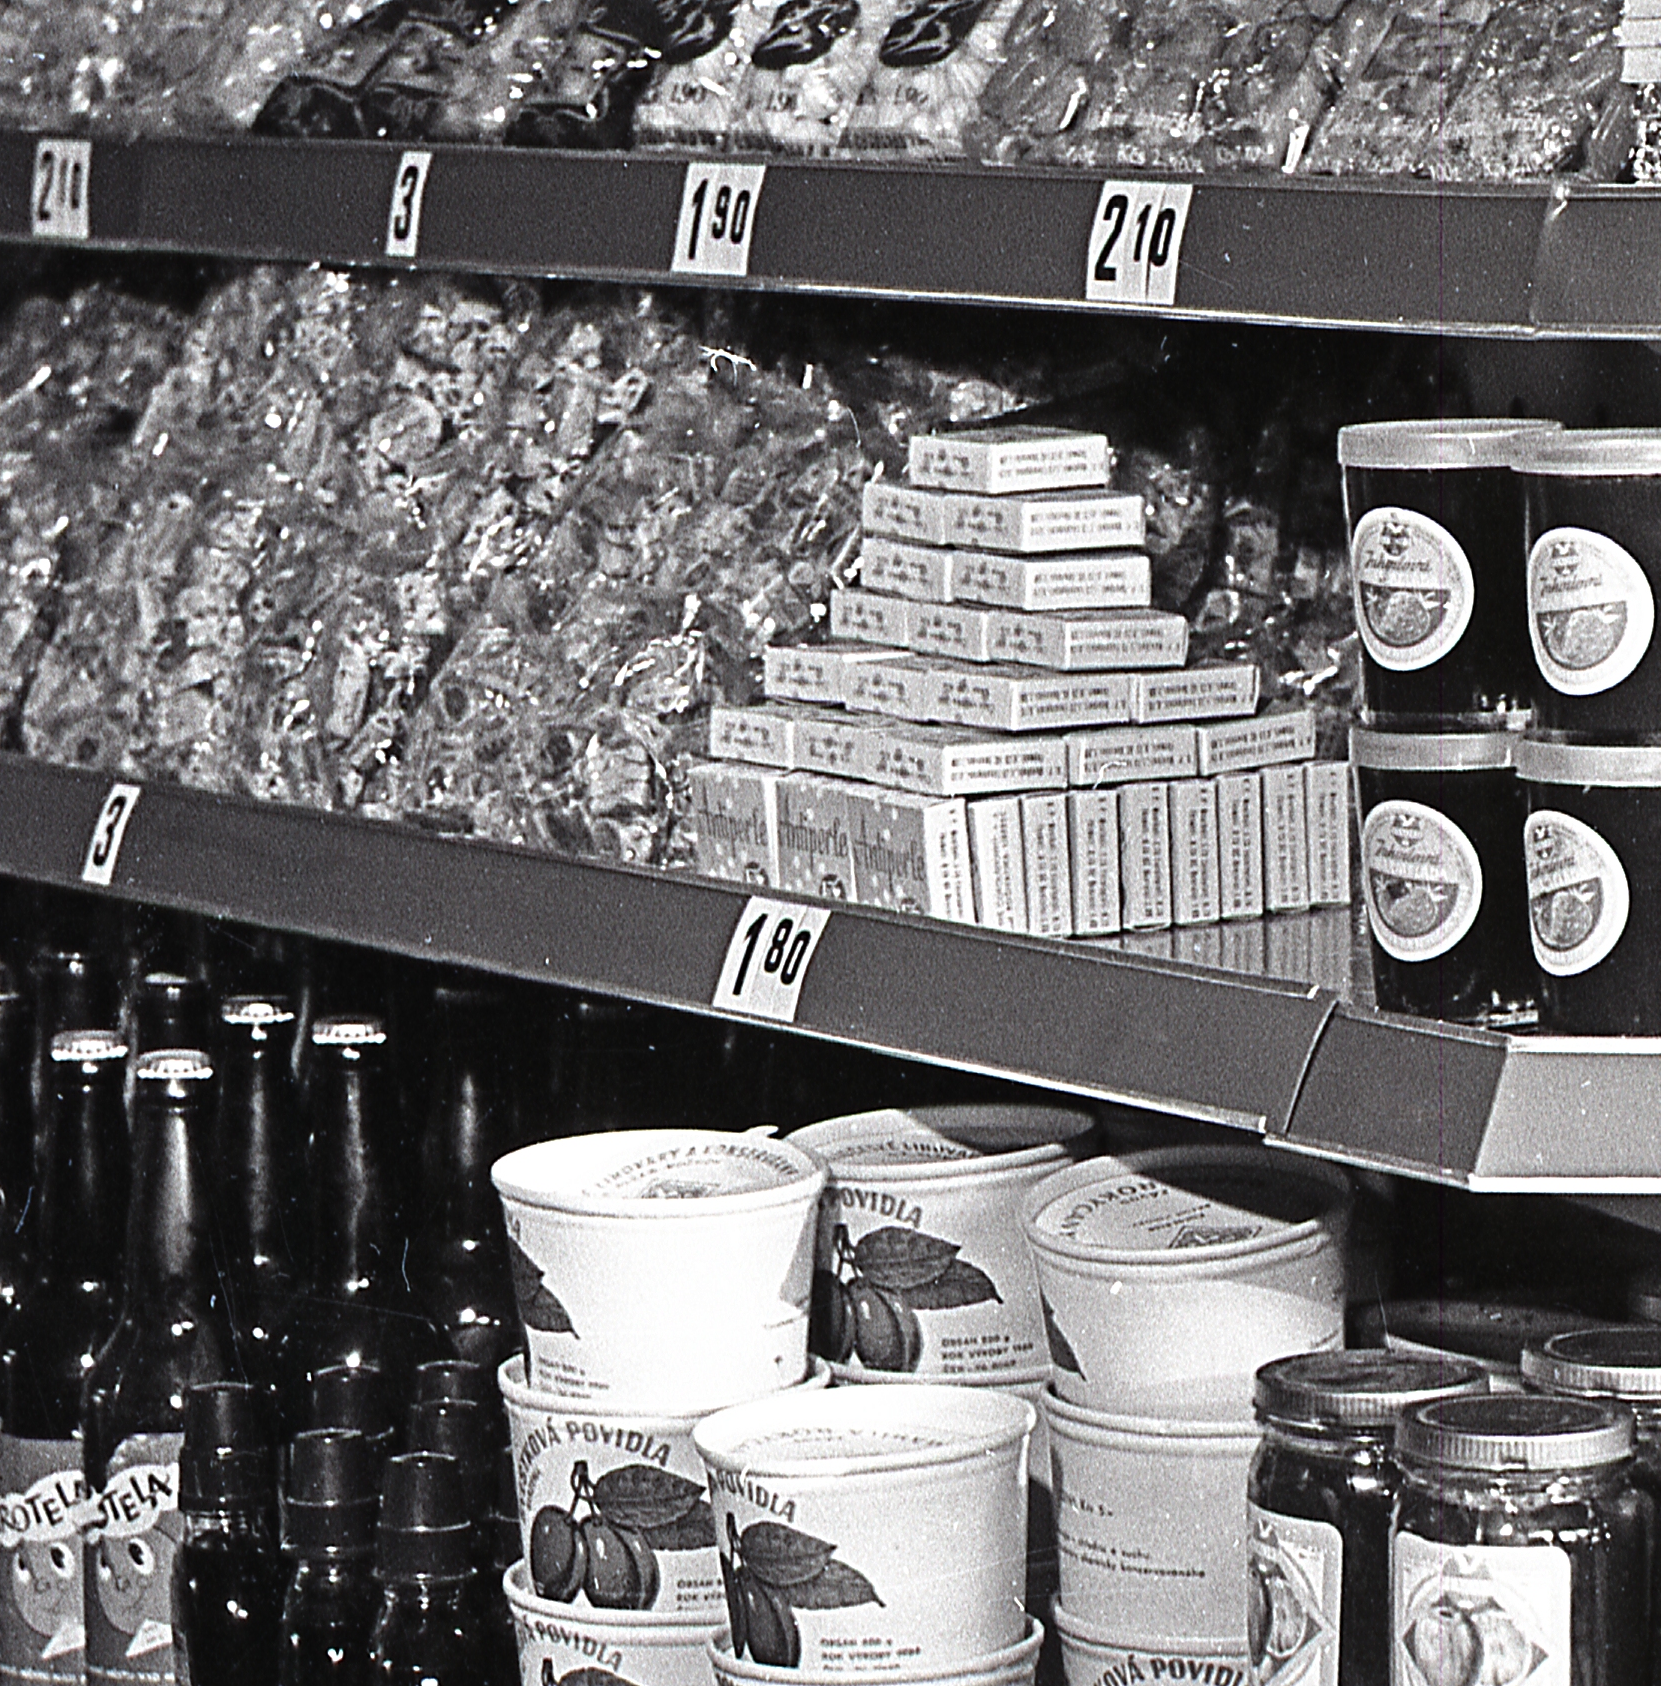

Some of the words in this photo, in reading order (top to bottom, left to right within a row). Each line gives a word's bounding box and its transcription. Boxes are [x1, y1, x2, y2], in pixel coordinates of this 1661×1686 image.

[394, 165, 417, 240] 3
[92, 795, 125, 870] 3
[565, 1420, 672, 1467] POVIDLA
[536, 1619, 624, 1672] POVIDLA
